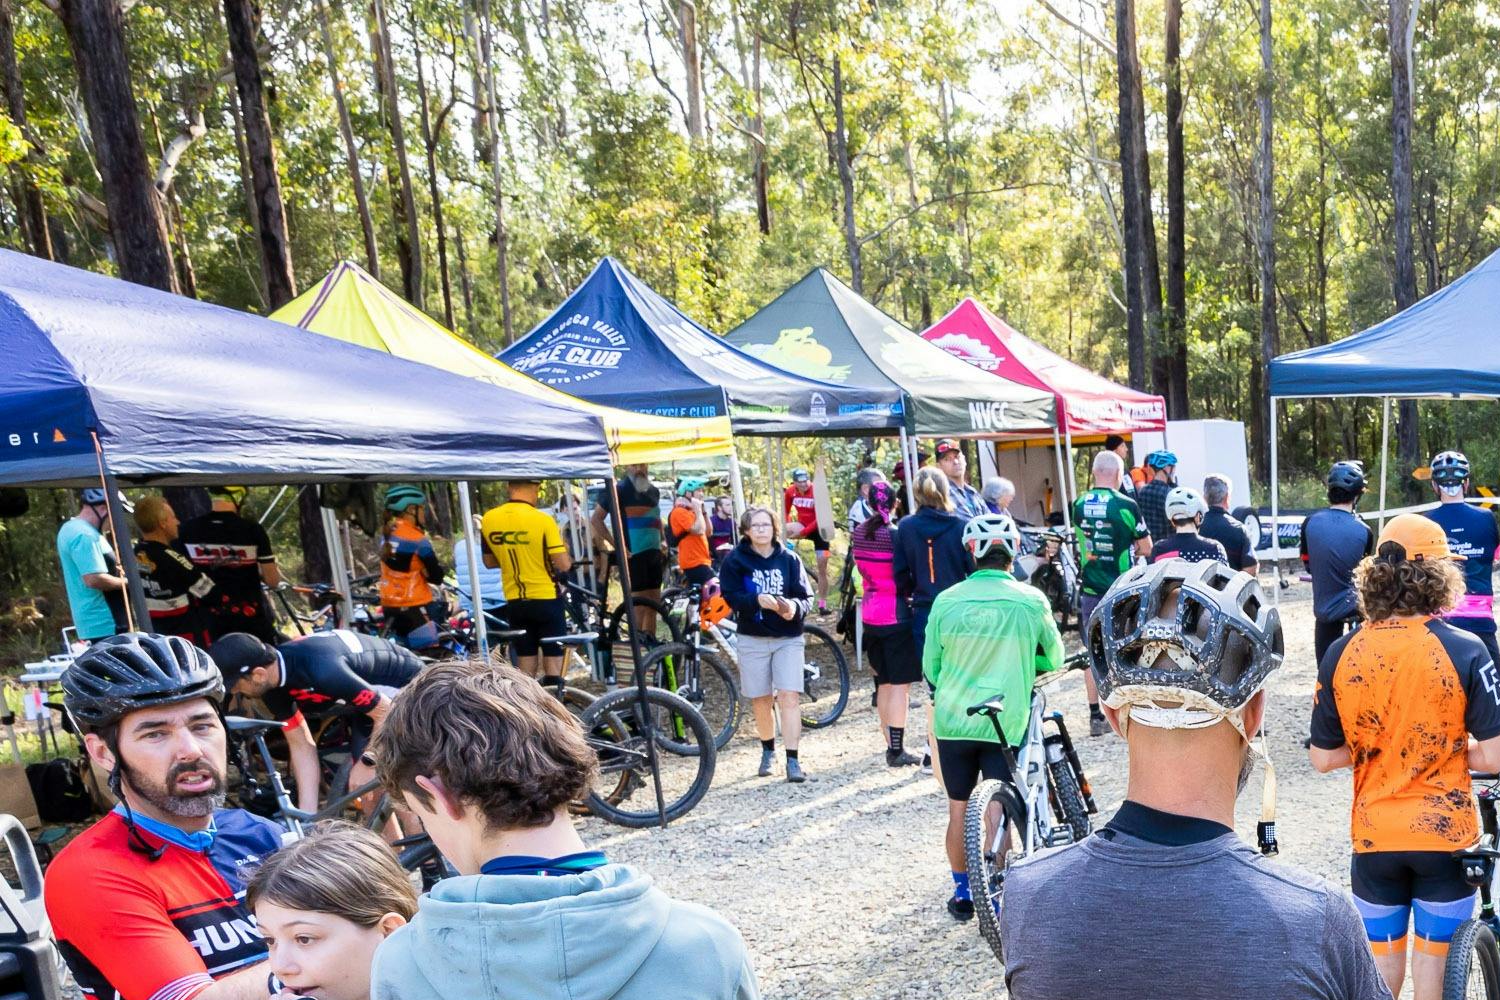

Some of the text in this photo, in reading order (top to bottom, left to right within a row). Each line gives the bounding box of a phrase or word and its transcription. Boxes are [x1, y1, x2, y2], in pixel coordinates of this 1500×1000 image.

[592, 319, 627, 347] VALLEY
[565, 348, 623, 368] CLUB
[968, 401, 1013, 430] NVCC
[488, 531, 530, 545] GCC
